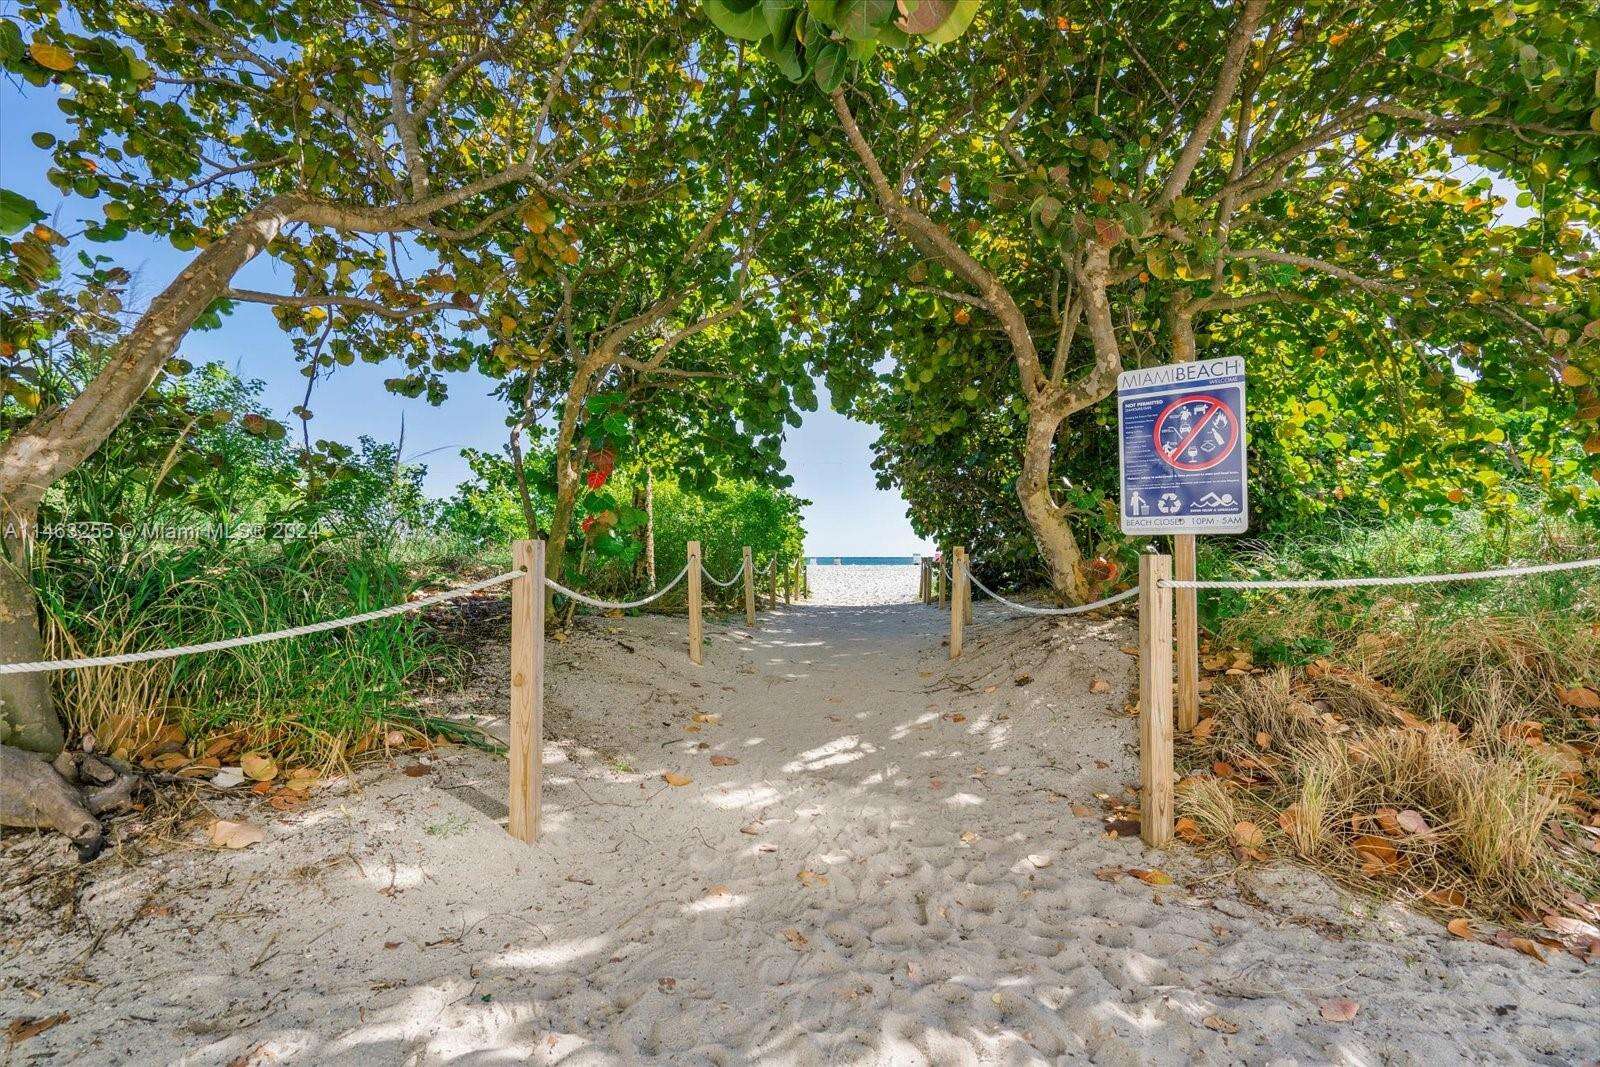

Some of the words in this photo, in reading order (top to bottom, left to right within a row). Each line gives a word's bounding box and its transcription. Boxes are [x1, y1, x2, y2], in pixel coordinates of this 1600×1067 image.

[1121, 360, 1238, 389] MIAMIBEACH
[1209, 376, 1238, 385] WELCOME
[1126, 518, 1152, 527] BEACH
[1154, 518, 1185, 526] CLOSED
